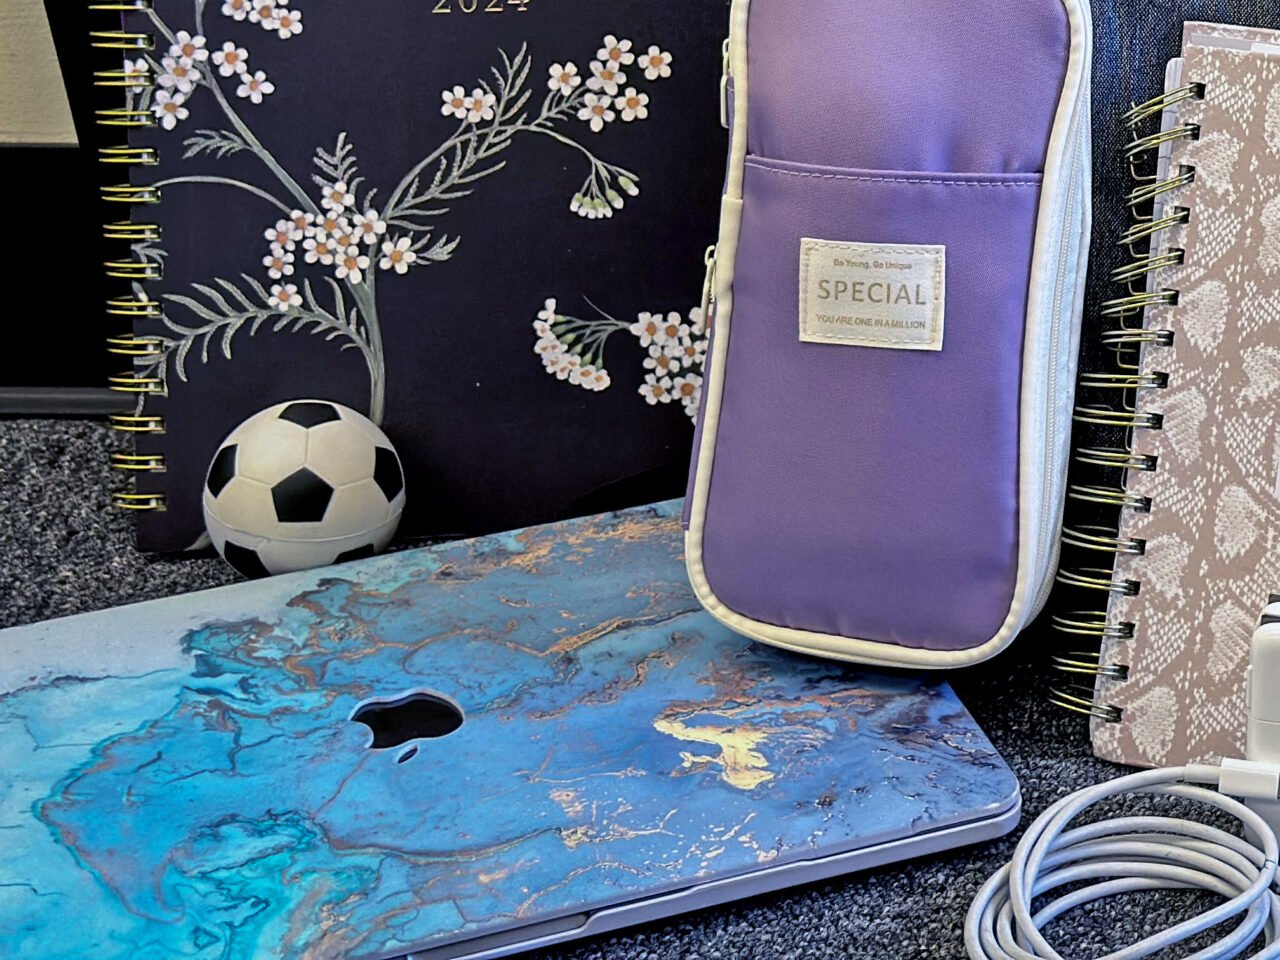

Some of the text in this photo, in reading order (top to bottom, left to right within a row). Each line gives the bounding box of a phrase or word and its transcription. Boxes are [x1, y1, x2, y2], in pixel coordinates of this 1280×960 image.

[885, 262, 912, 271] Unique
[817, 279, 926, 306] SPECIAL
[816, 314, 834, 324] YOU
[835, 316, 852, 326] ARE
[854, 317, 873, 327] ONE
[875, 319, 883, 328] IN
[891, 320, 926, 330] MILLION
